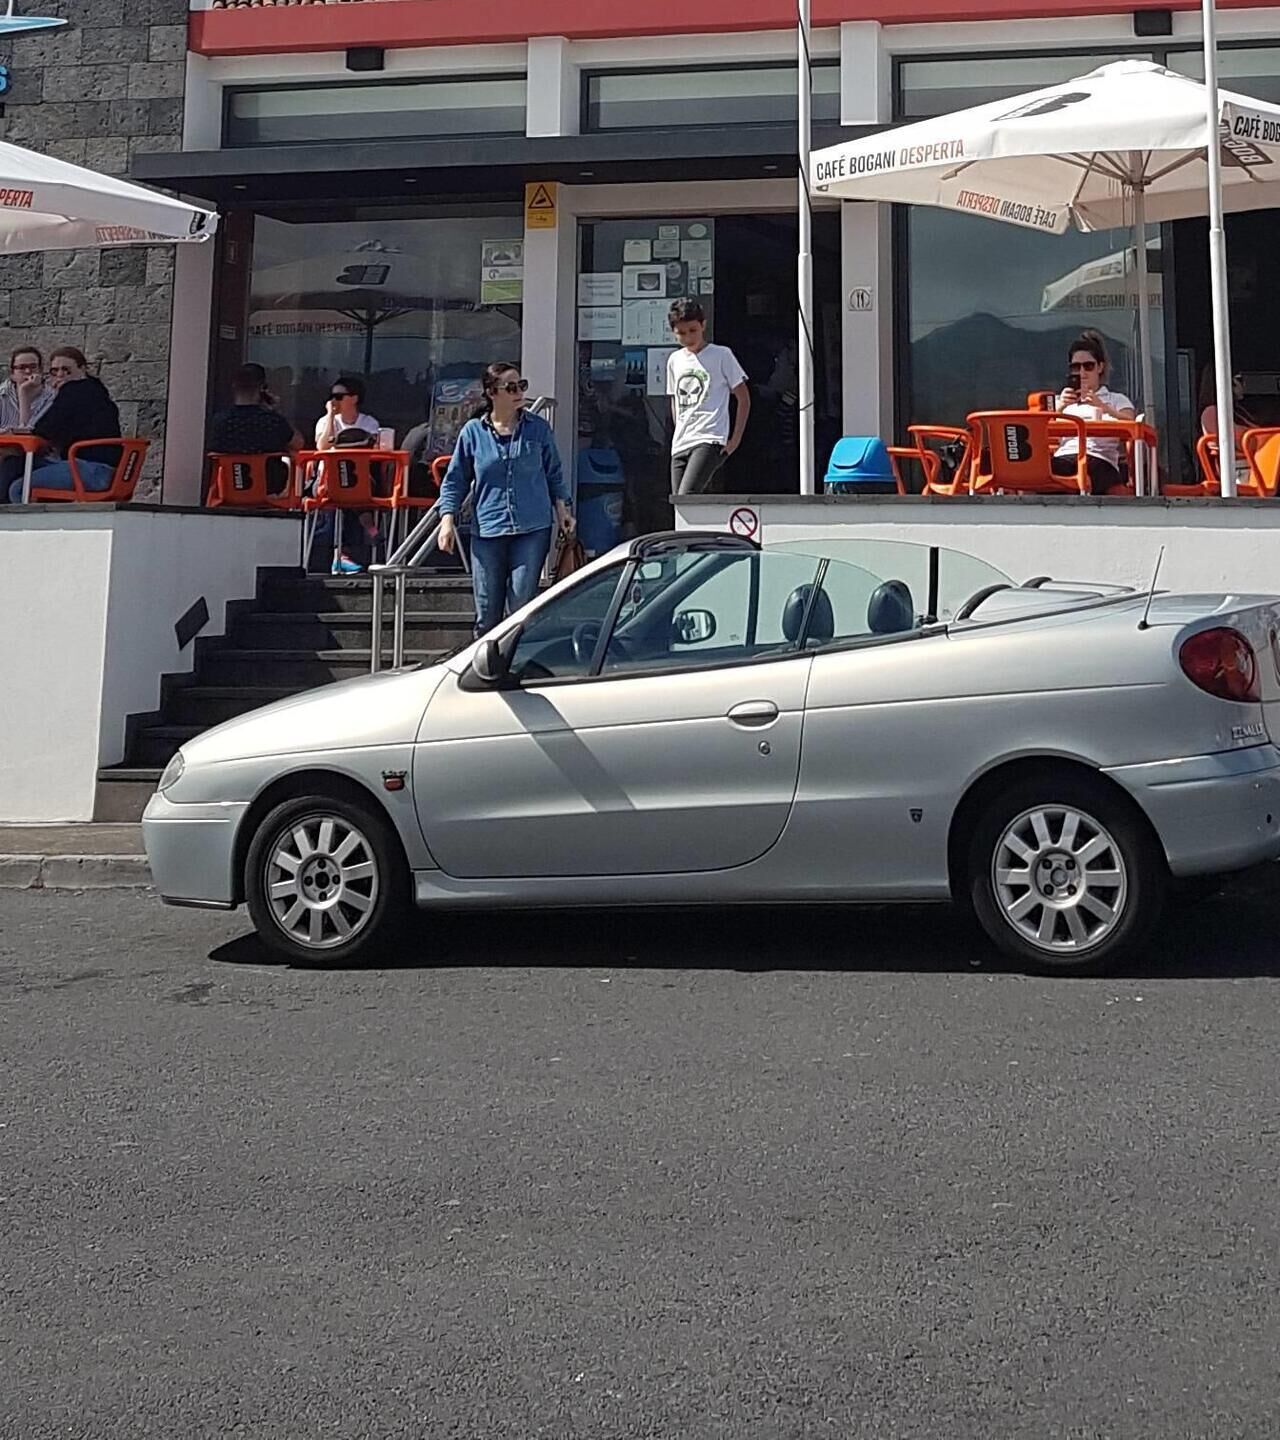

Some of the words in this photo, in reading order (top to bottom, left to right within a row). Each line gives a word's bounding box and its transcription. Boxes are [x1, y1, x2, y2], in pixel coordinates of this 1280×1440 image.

[1233, 114, 1261, 140] CAFÉ
[816, 154, 846, 181] CAFÉ
[849, 150, 897, 175] BOGANI
[899, 139, 965, 167] DESPERTA
[1005, 425, 1019, 460] BOGANI
